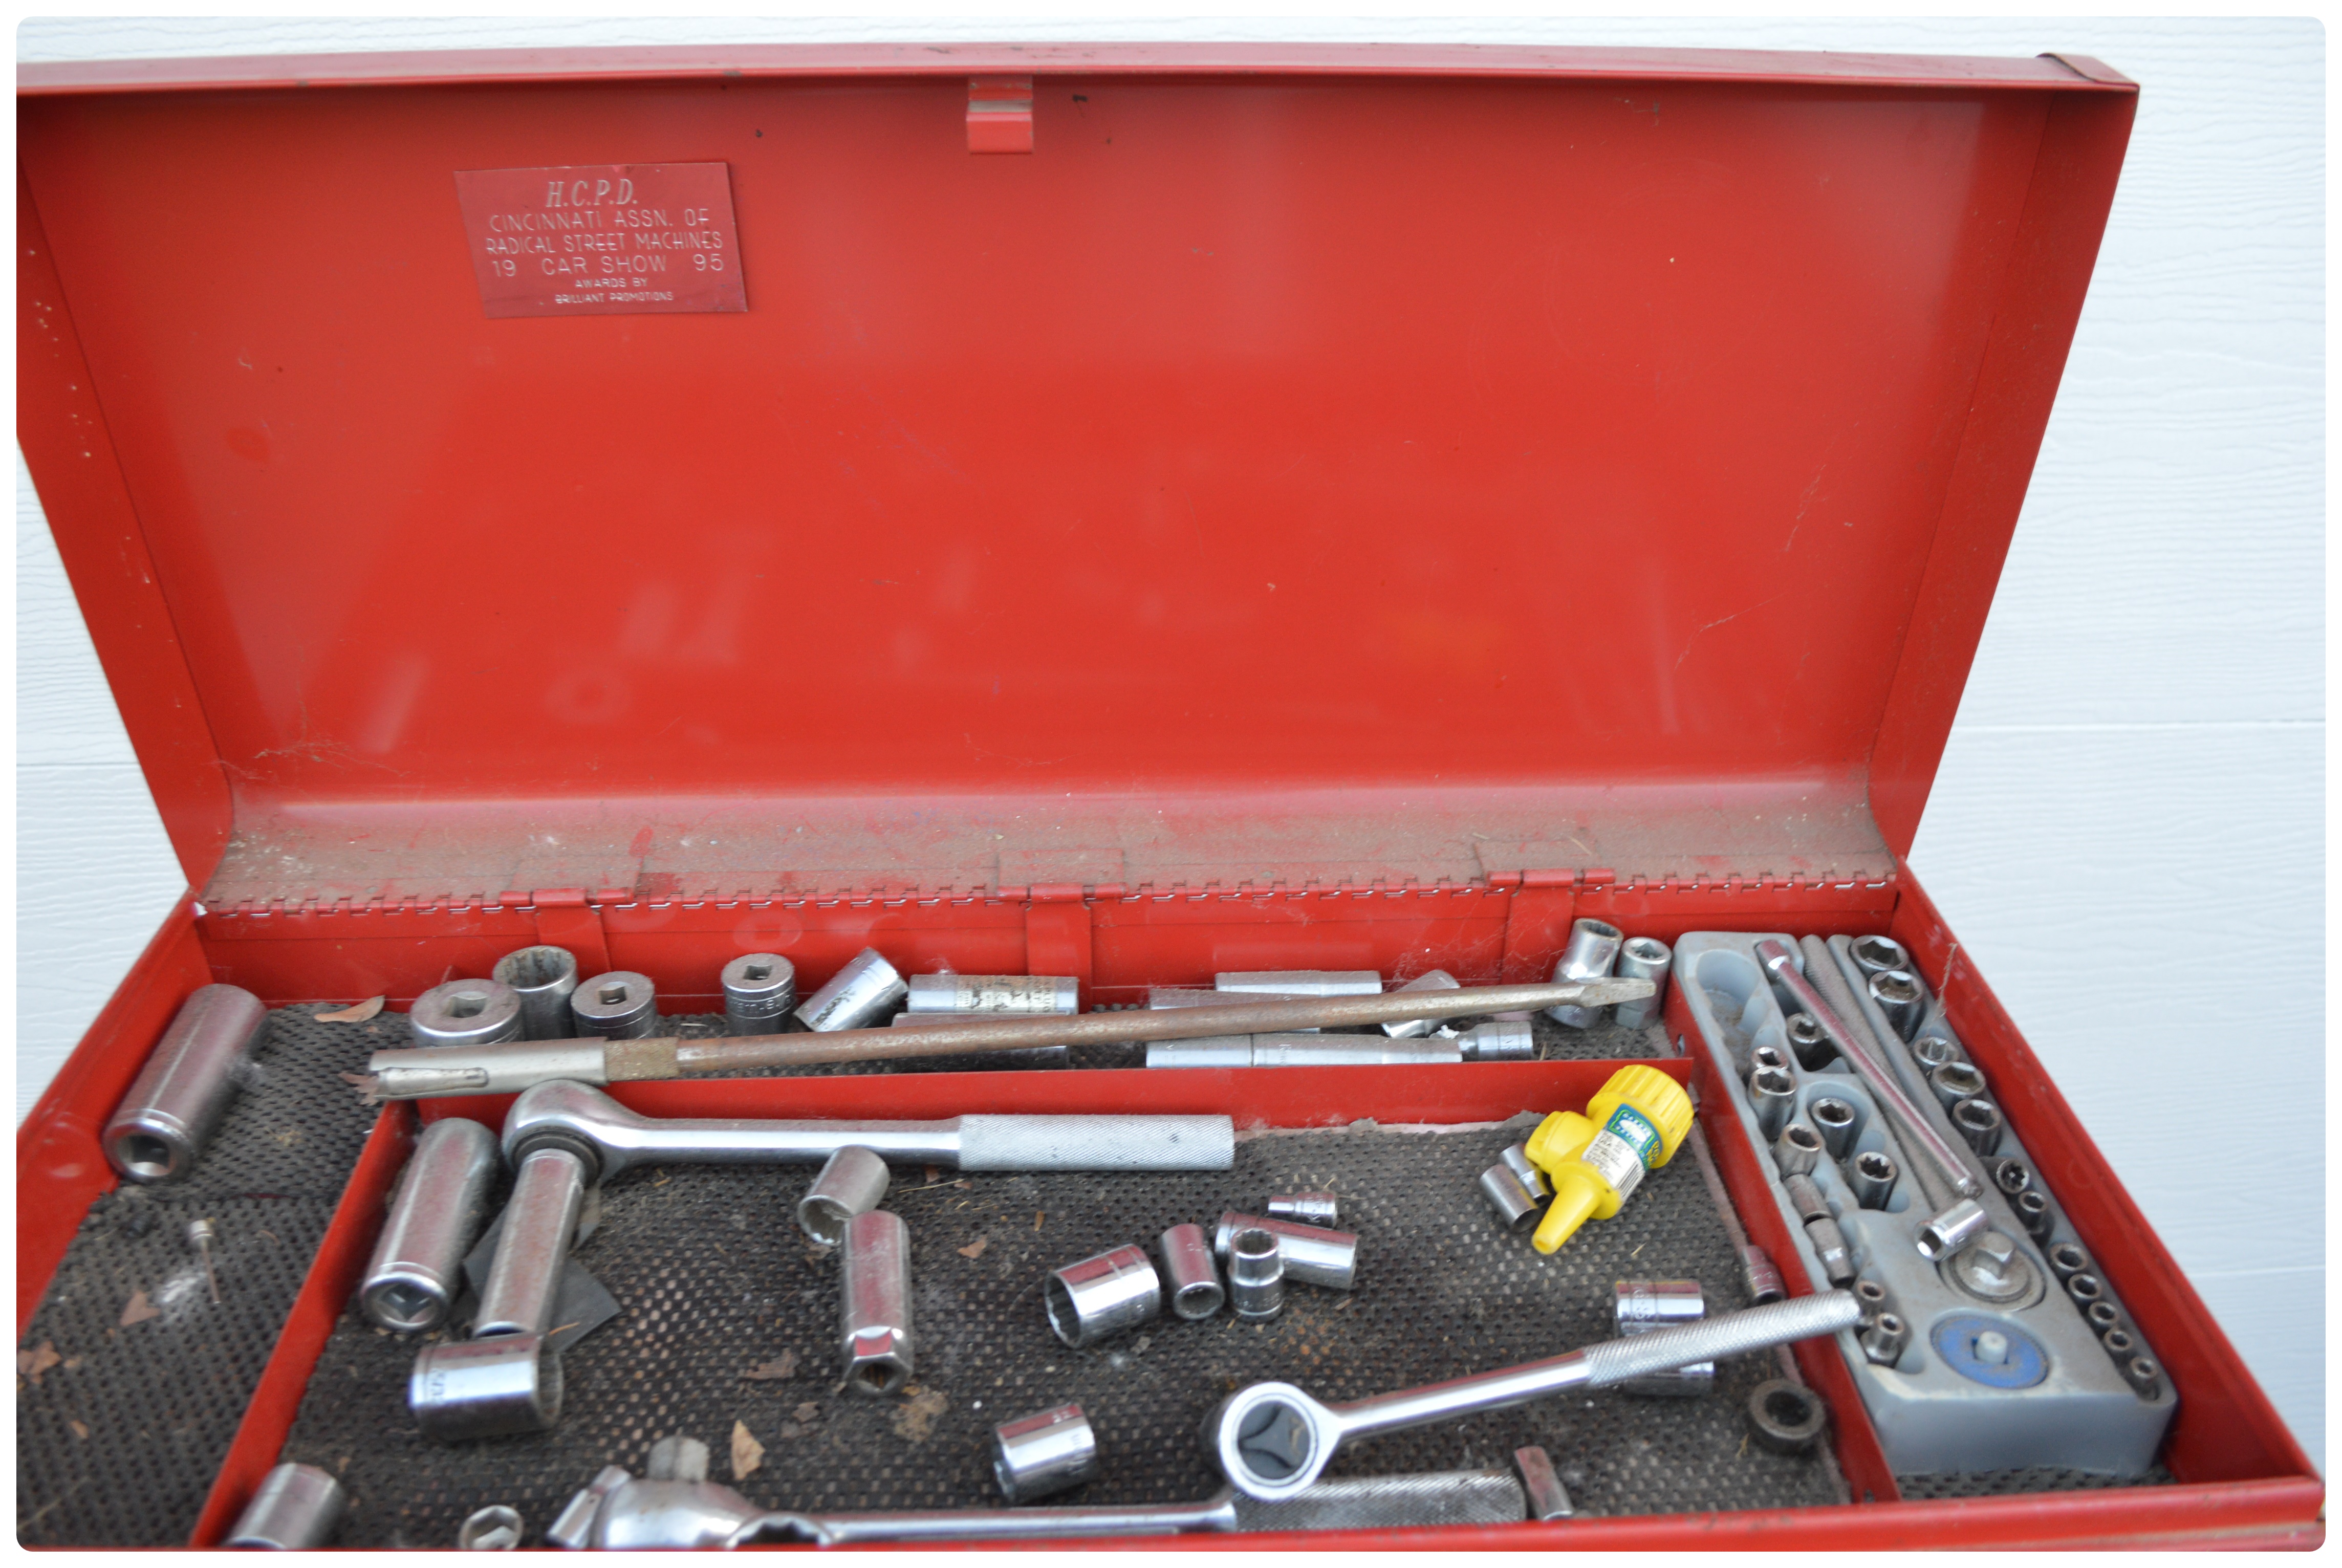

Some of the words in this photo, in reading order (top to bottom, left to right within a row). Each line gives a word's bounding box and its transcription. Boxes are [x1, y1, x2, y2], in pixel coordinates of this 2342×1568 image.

[545, 179, 638, 208] H.C.P.D.
[489, 210, 602, 232] CINCINNATI
[615, 209, 674, 227] ASSN.
[684, 208, 709, 226] OF
[486, 236, 556, 255] RADICAL
[563, 232, 625, 252] STREET
[634, 231, 723, 250] MACHINES
[492, 259, 517, 277] 19
[541, 257, 589, 275] CAR
[600, 255, 666, 274] SHOW
[692, 253, 725, 272] 95
[574, 277, 627, 288] AWARDS
[632, 277, 648, 287] BY
[554, 292, 605, 304] BRILLIANT
[609, 291, 675, 302] PROMOTIONS
